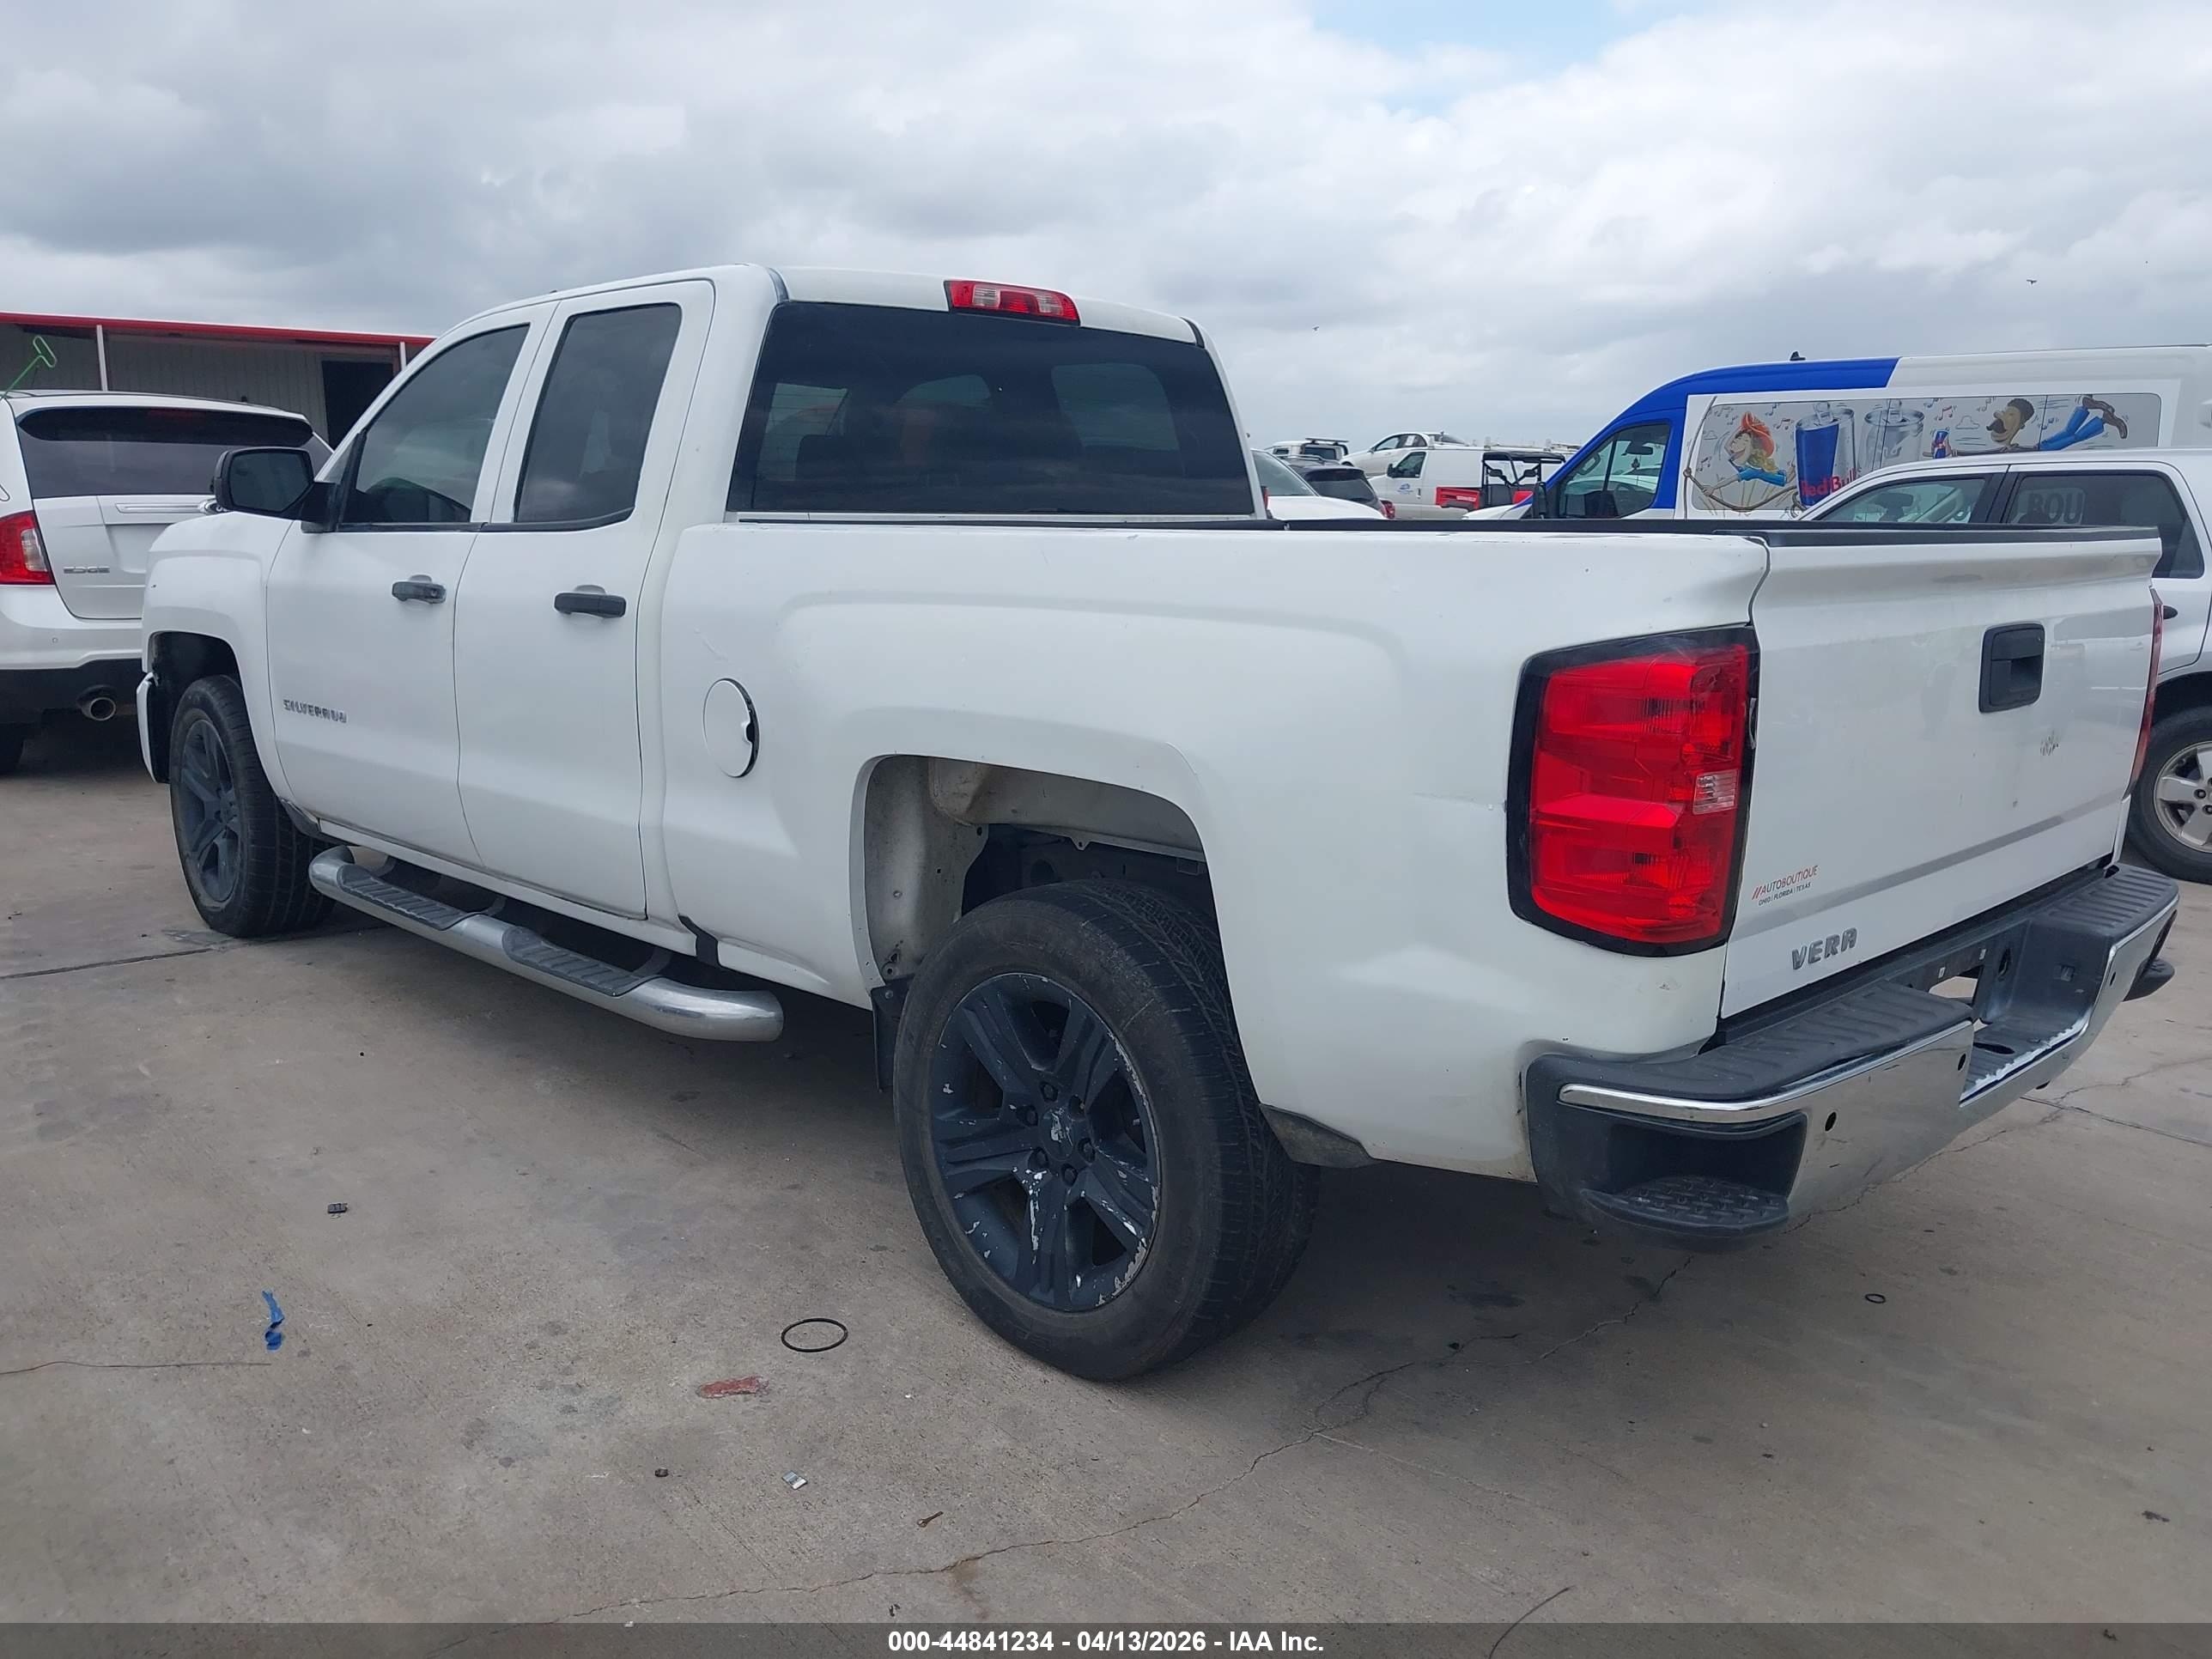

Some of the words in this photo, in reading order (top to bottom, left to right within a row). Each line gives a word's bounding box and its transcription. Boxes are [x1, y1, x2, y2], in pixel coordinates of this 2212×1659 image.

[1800, 477, 1828, 495] Red
[63, 566, 111, 574] EDGE
[283, 698, 348, 723] SILVERADO
[1773, 887, 1793, 901] FLORIDA
[1796, 881, 1811, 893] TEXAS
[1791, 927, 1858, 970] VERA
